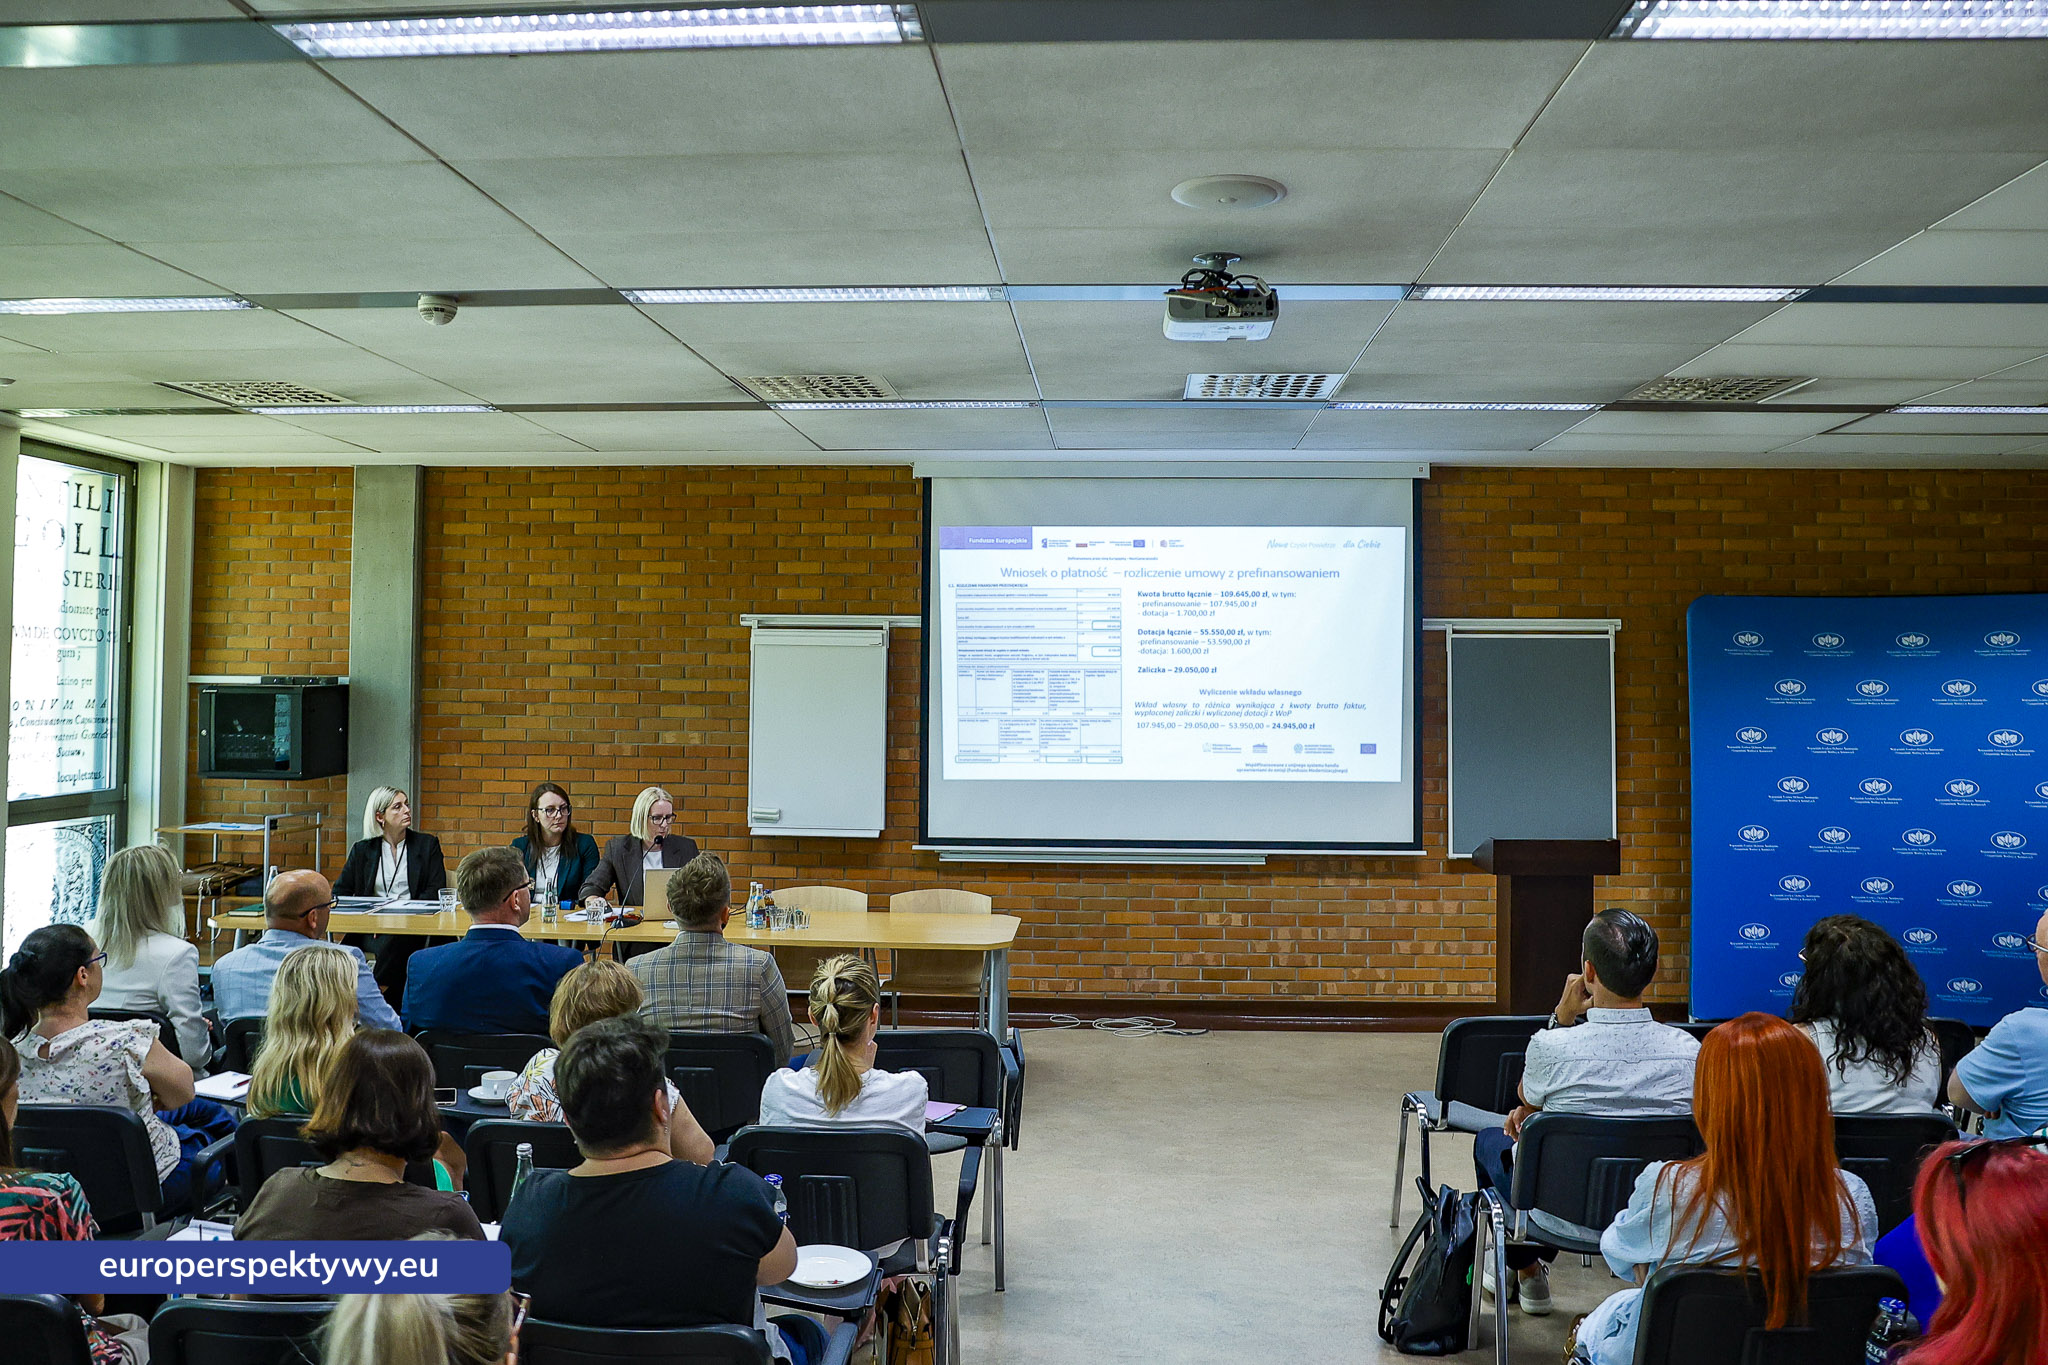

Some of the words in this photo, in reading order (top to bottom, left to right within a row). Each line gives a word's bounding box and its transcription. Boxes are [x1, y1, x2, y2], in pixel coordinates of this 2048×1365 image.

[995, 537, 1028, 545] Europejskie
[1267, 539, 1289, 549] Nowe
[1343, 540, 1355, 548] dla
[1357, 539, 1381, 549] Ciebie
[1000, 568, 1048, 578] Wniosek
[1051, 570, 1058, 578] o
[1061, 567, 1108, 580] płatność
[1124, 568, 1181, 578] rozliczenie
[1185, 570, 1225, 580] umowy
[1228, 570, 1234, 578] z
[1237, 568, 1340, 580] prefinansowaniem
[1199, 688, 1238, 697] Wyliczenie
[1240, 688, 1266, 696] wkładu
[1268, 688, 1302, 697] własnego
[1162, 702, 1188, 710] własny
[1205, 701, 1230, 709] różnica
[1236, 702, 1275, 711] wynikająca
[1289, 702, 1312, 711] kwoty
[1344, 702, 1367, 711] faktur,
[1134, 709, 1175, 717] wypłaconej
[1206, 710, 1243, 718] wyliczonej
[1245, 710, 1269, 718] dotacji
[1136, 722, 1176, 730] 107.945,00
[1184, 722, 1219, 730] 29.050,00
[1229, 722, 1264, 730] 53.950,00
[1272, 722, 1308, 730] 24.945,00
